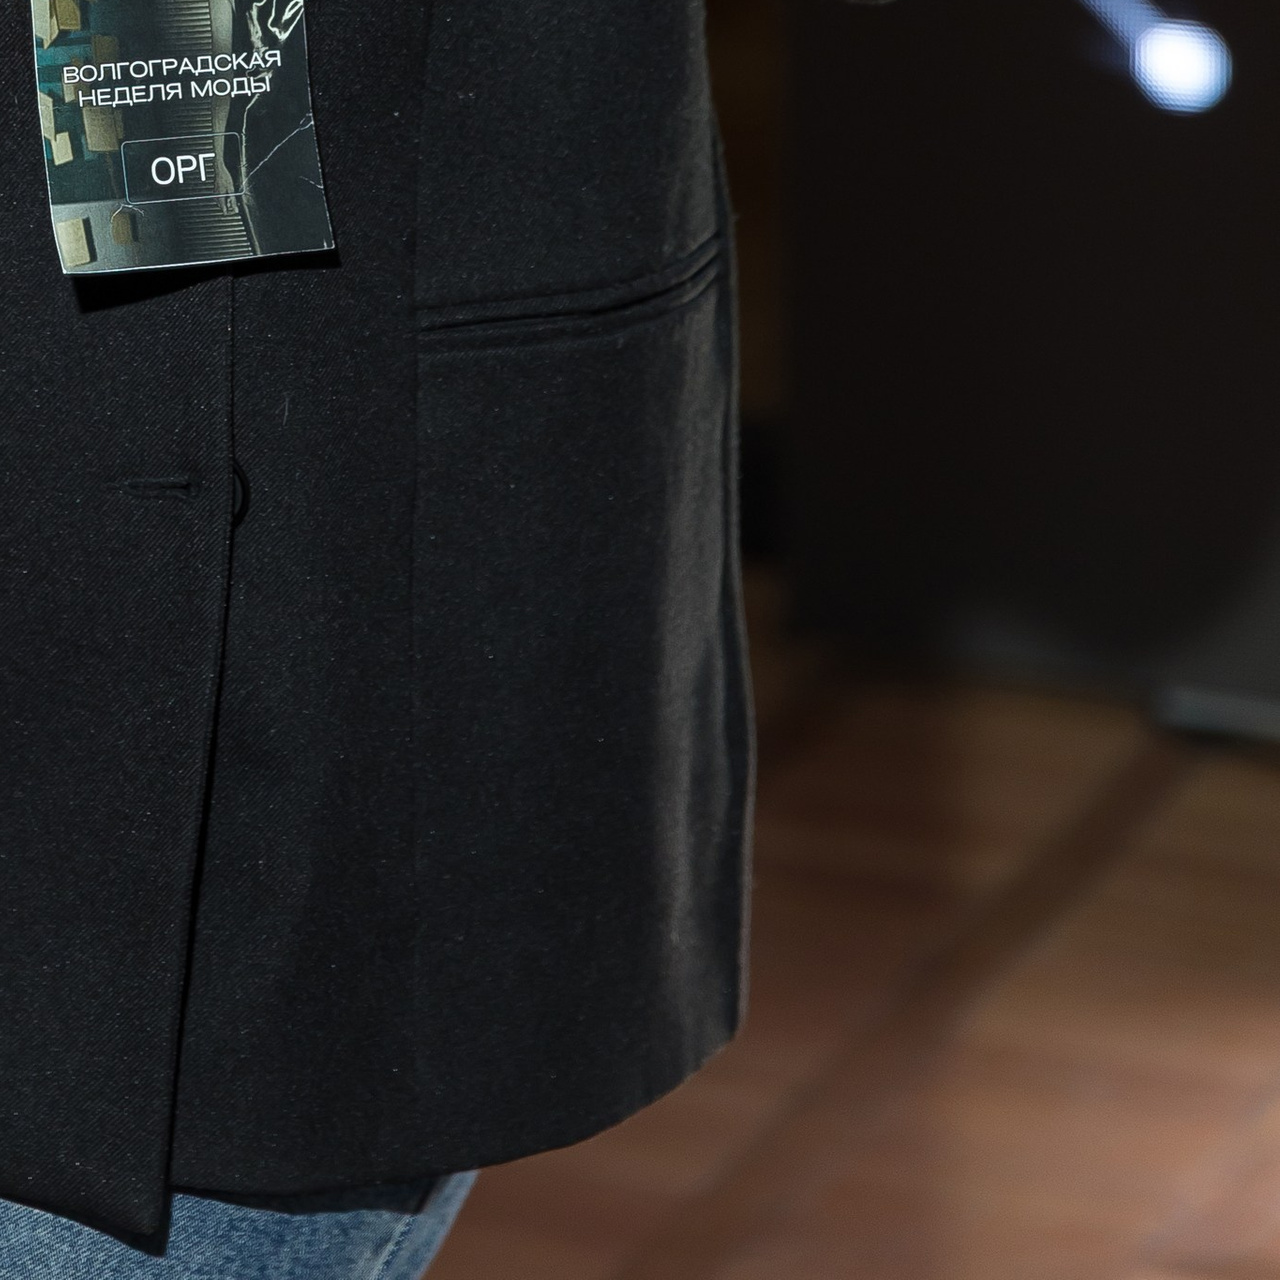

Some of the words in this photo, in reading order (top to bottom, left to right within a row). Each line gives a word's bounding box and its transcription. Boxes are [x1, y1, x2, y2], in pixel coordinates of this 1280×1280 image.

[62, 50, 282, 84] ВОЛГОГРАДСКАЯ
[78, 83, 183, 108] НЕДЕЛЯ
[190, 75, 271, 99] МОДЫ
[151, 152, 216, 186] ОРГ
